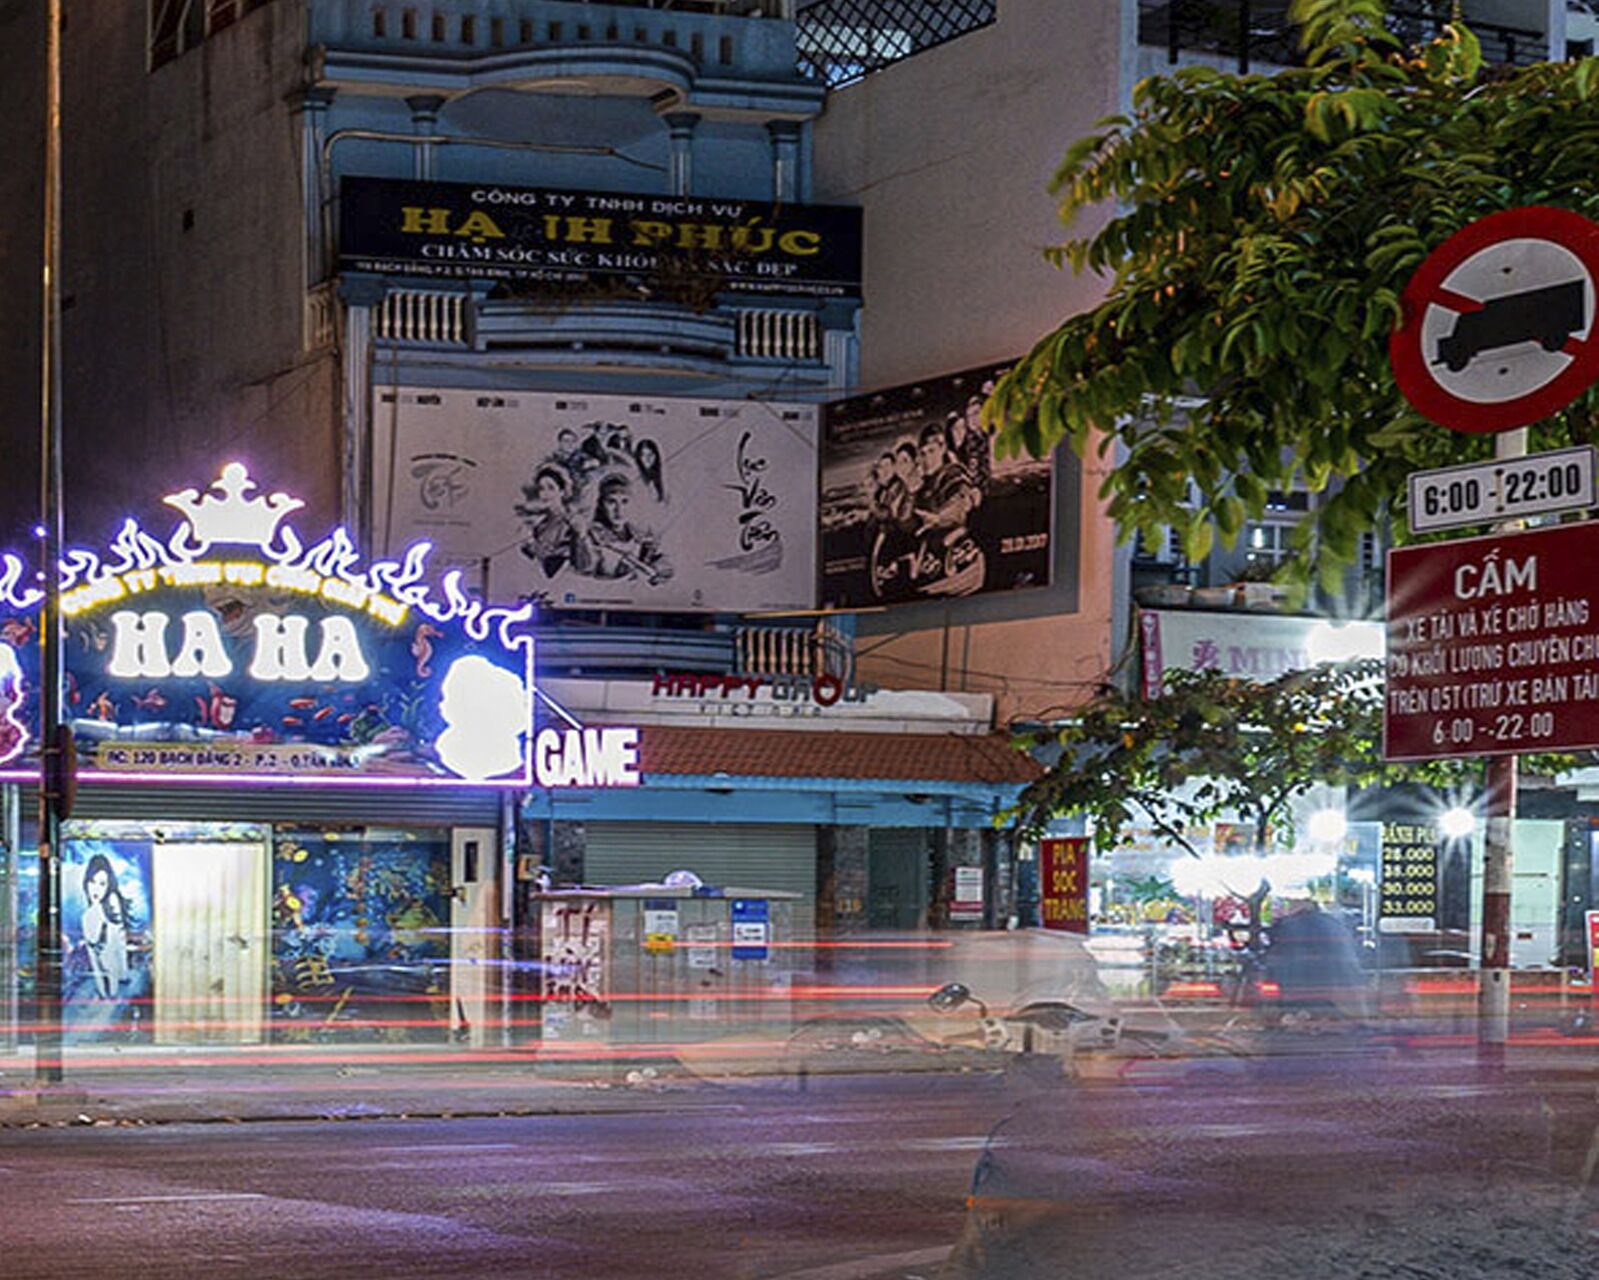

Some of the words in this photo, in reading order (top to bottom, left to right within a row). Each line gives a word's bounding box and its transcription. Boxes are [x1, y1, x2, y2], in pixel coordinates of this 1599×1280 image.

[546, 194, 575, 207] TY
[585, 196, 643, 211] TNHH
[631, 216, 822, 255] PHÚC
[1425, 478, 1478, 515] 6:00
[1505, 464, 1580, 504] 22:00
[1454, 548, 1537, 598] CẤM
[108, 611, 233, 678] HA
[249, 613, 370, 681] HA
[1407, 617, 1425, 641] XE
[652, 673, 765, 698] HAPPY
[771, 673, 880, 706] GROUP
[1506, 680, 1528, 706] XE
[536, 728, 639, 787] GAME
[1053, 843, 1075, 865] PIA
